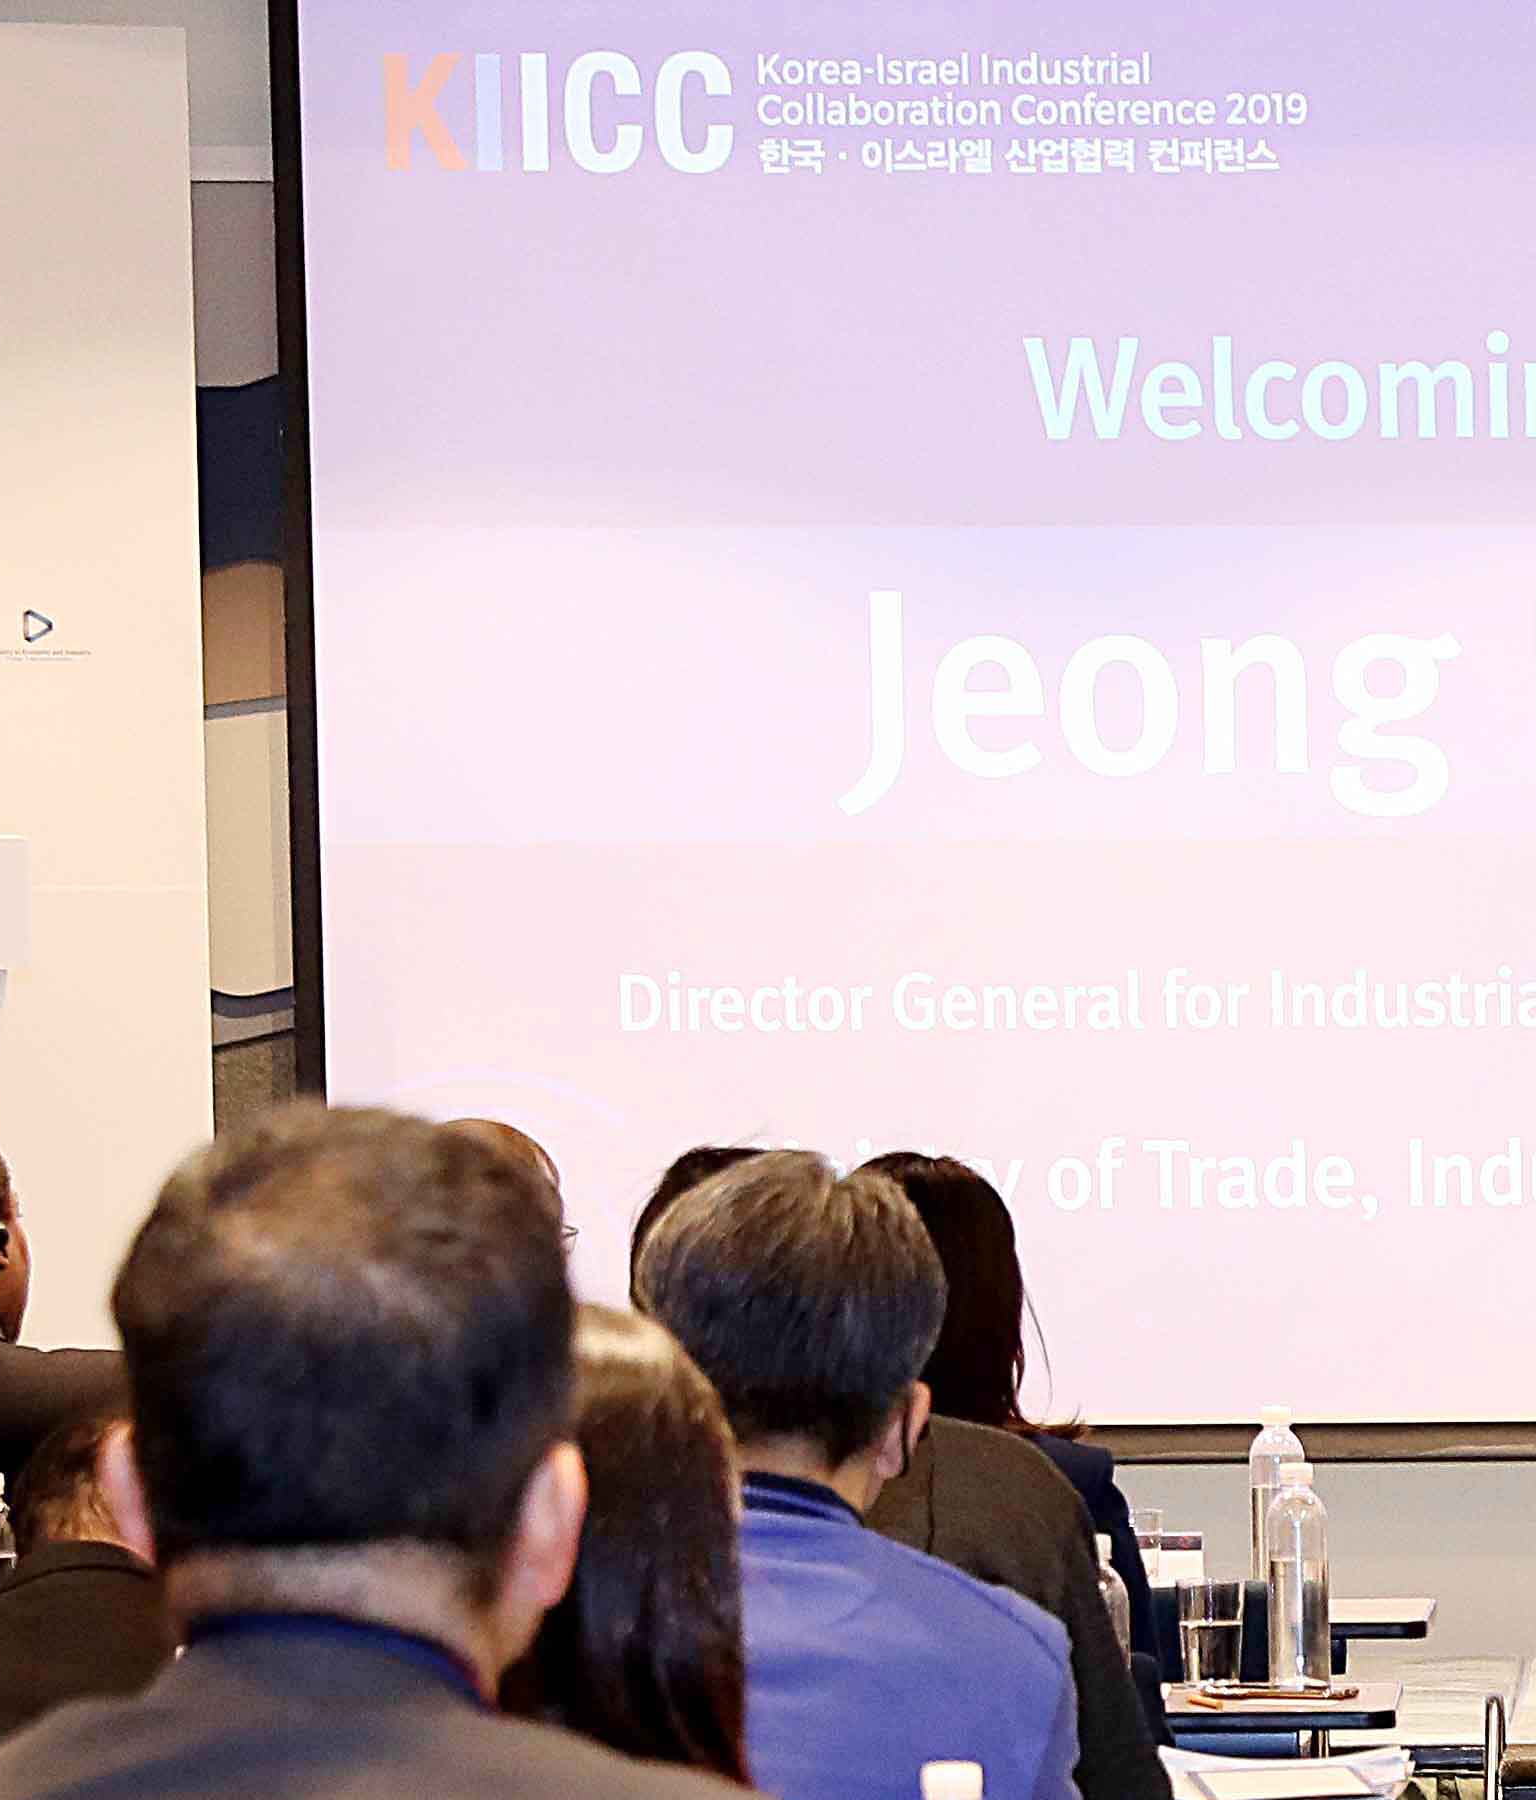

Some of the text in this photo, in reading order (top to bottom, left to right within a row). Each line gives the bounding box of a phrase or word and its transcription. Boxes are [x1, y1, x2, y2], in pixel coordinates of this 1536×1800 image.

[757, 53, 1150, 85] Korea-Israel Industrial
[383, 52, 732, 173] KIICC
[757, 94, 1307, 127] Collaboration Conference 2019
[758, 138, 1279, 173] 한국 이스라엘 산업협력 컨퍼런스
[838, 588, 1461, 818] Jeong
[618, 971, 871, 1031] Director
[893, 972, 1144, 1030] General
[1162, 971, 1249, 1030] for
[1047, 1138, 1126, 1211] of
[1142, 1140, 1378, 1217] Trade,
